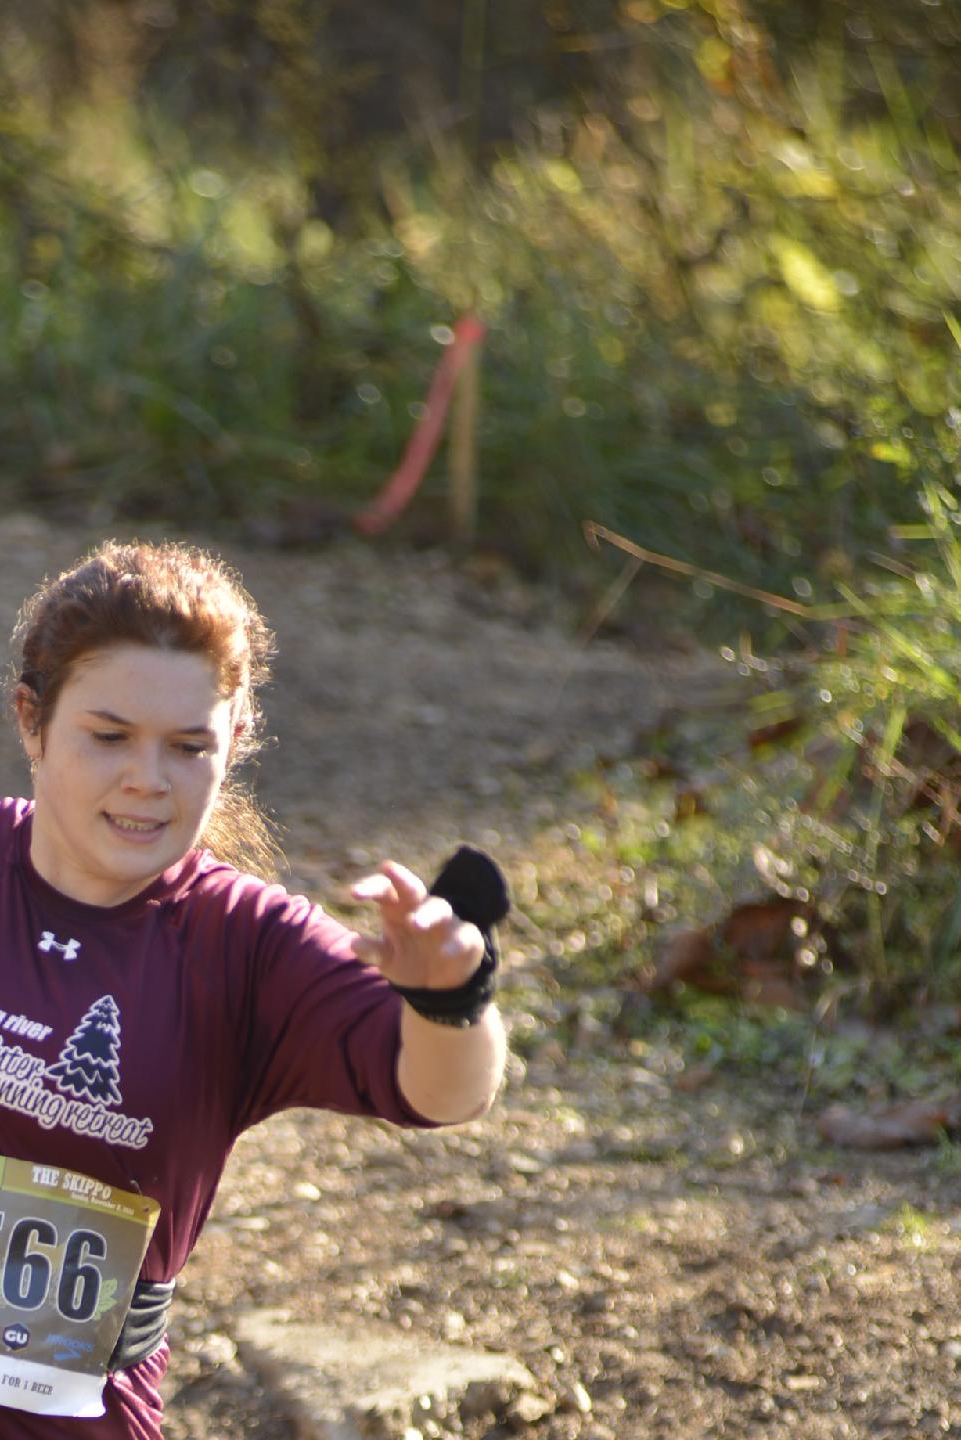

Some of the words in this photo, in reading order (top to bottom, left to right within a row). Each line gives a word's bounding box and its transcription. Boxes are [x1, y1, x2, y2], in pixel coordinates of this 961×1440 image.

[2, 1014, 53, 1041] river
[60, 1100, 153, 1149] retreat
[32, 1165, 60, 1187] THE
[62, 1172, 112, 1199] SKIPPO
[4, 1331, 27, 1345] GU
[1, 1373, 21, 1389] FOR
[31, 1381, 53, 1396] BEER
